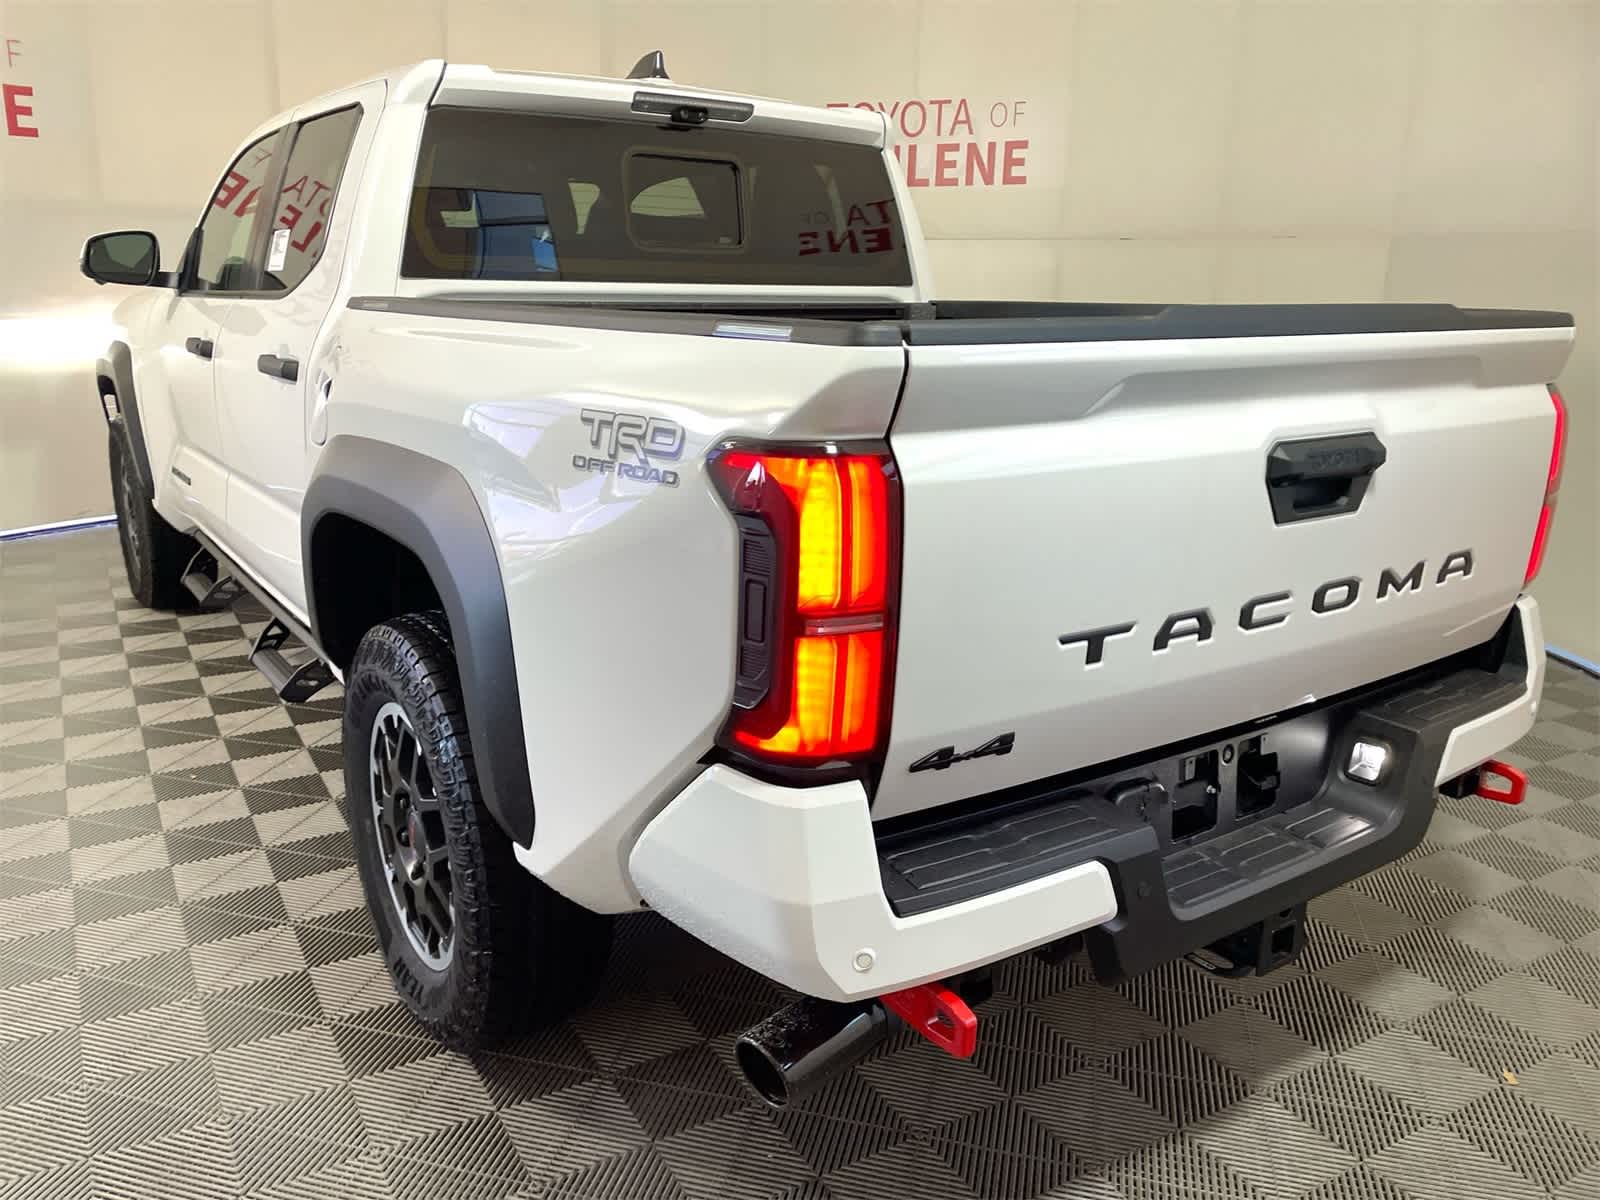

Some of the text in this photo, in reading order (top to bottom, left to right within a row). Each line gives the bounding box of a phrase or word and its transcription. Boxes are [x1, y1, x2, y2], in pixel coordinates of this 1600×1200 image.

[990, 101, 1027, 128] OF
[580, 408, 686, 466] TRD
[572, 455, 680, 488] OFF ROAD
[1058, 548, 1475, 669] TACOMA
